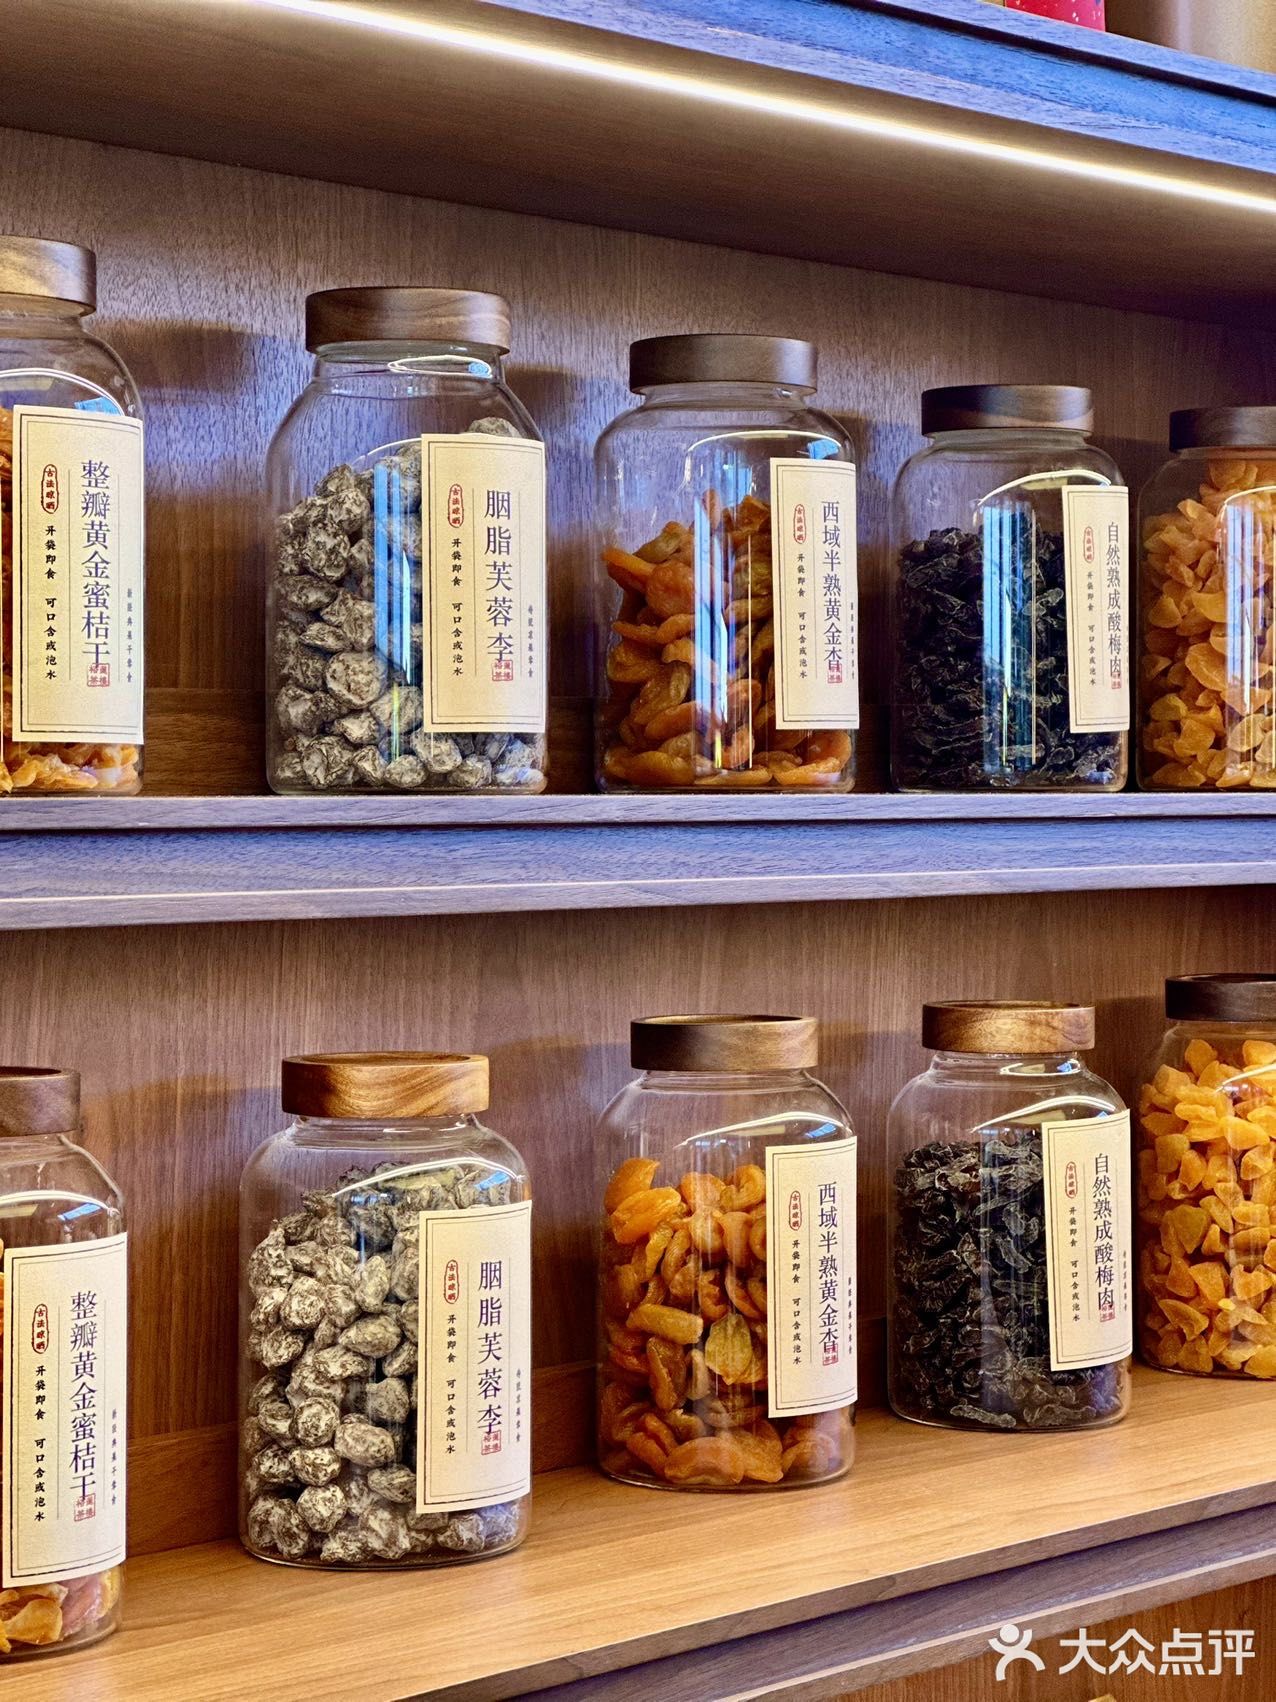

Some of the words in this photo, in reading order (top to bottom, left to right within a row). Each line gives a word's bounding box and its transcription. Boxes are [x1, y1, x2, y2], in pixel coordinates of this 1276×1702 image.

[45, 526, 56, 579] 开袋即食
[81, 460, 110, 667] 整瓣黄金蜜桔干
[452, 538, 462, 586] 开袋即食
[484, 490, 513, 661] 胭脂芙蓉李
[797, 554, 805, 597] 开袋即食
[822, 501, 842, 671] 西域半熟黄金杏
[1107, 522, 1121, 677] 自然熟成酸梅肉
[44, 598, 57, 680] 可口含或泡水
[452, 603, 463, 676] 可口含或泡水
[798, 612, 807, 678] 可口含或泡水
[1088, 625, 1096, 685] 可口含或泡水
[792, 1240, 800, 1283] 开袋即食
[1069, 1207, 1077, 1247] 开袋即食
[1093, 1153, 1114, 1311] 自然熟成酸梅肉
[818, 1182, 838, 1355] 西域半熟黄金杏
[1071, 1260, 1080, 1321] 可口含或泡水
[447, 1314, 456, 1363] 开袋即食
[478, 1261, 502, 1434] 胭脂芙蓉李
[793, 1298, 801, 1364] 可口含或泡水
[35, 1365, 46, 1420] 开袋即食
[69, 1291, 97, 1501] 整瓣黄金蜜桔干
[446, 1379, 456, 1454] 可口含或泡水
[33, 1438, 46, 1521] 可口含或泡水
